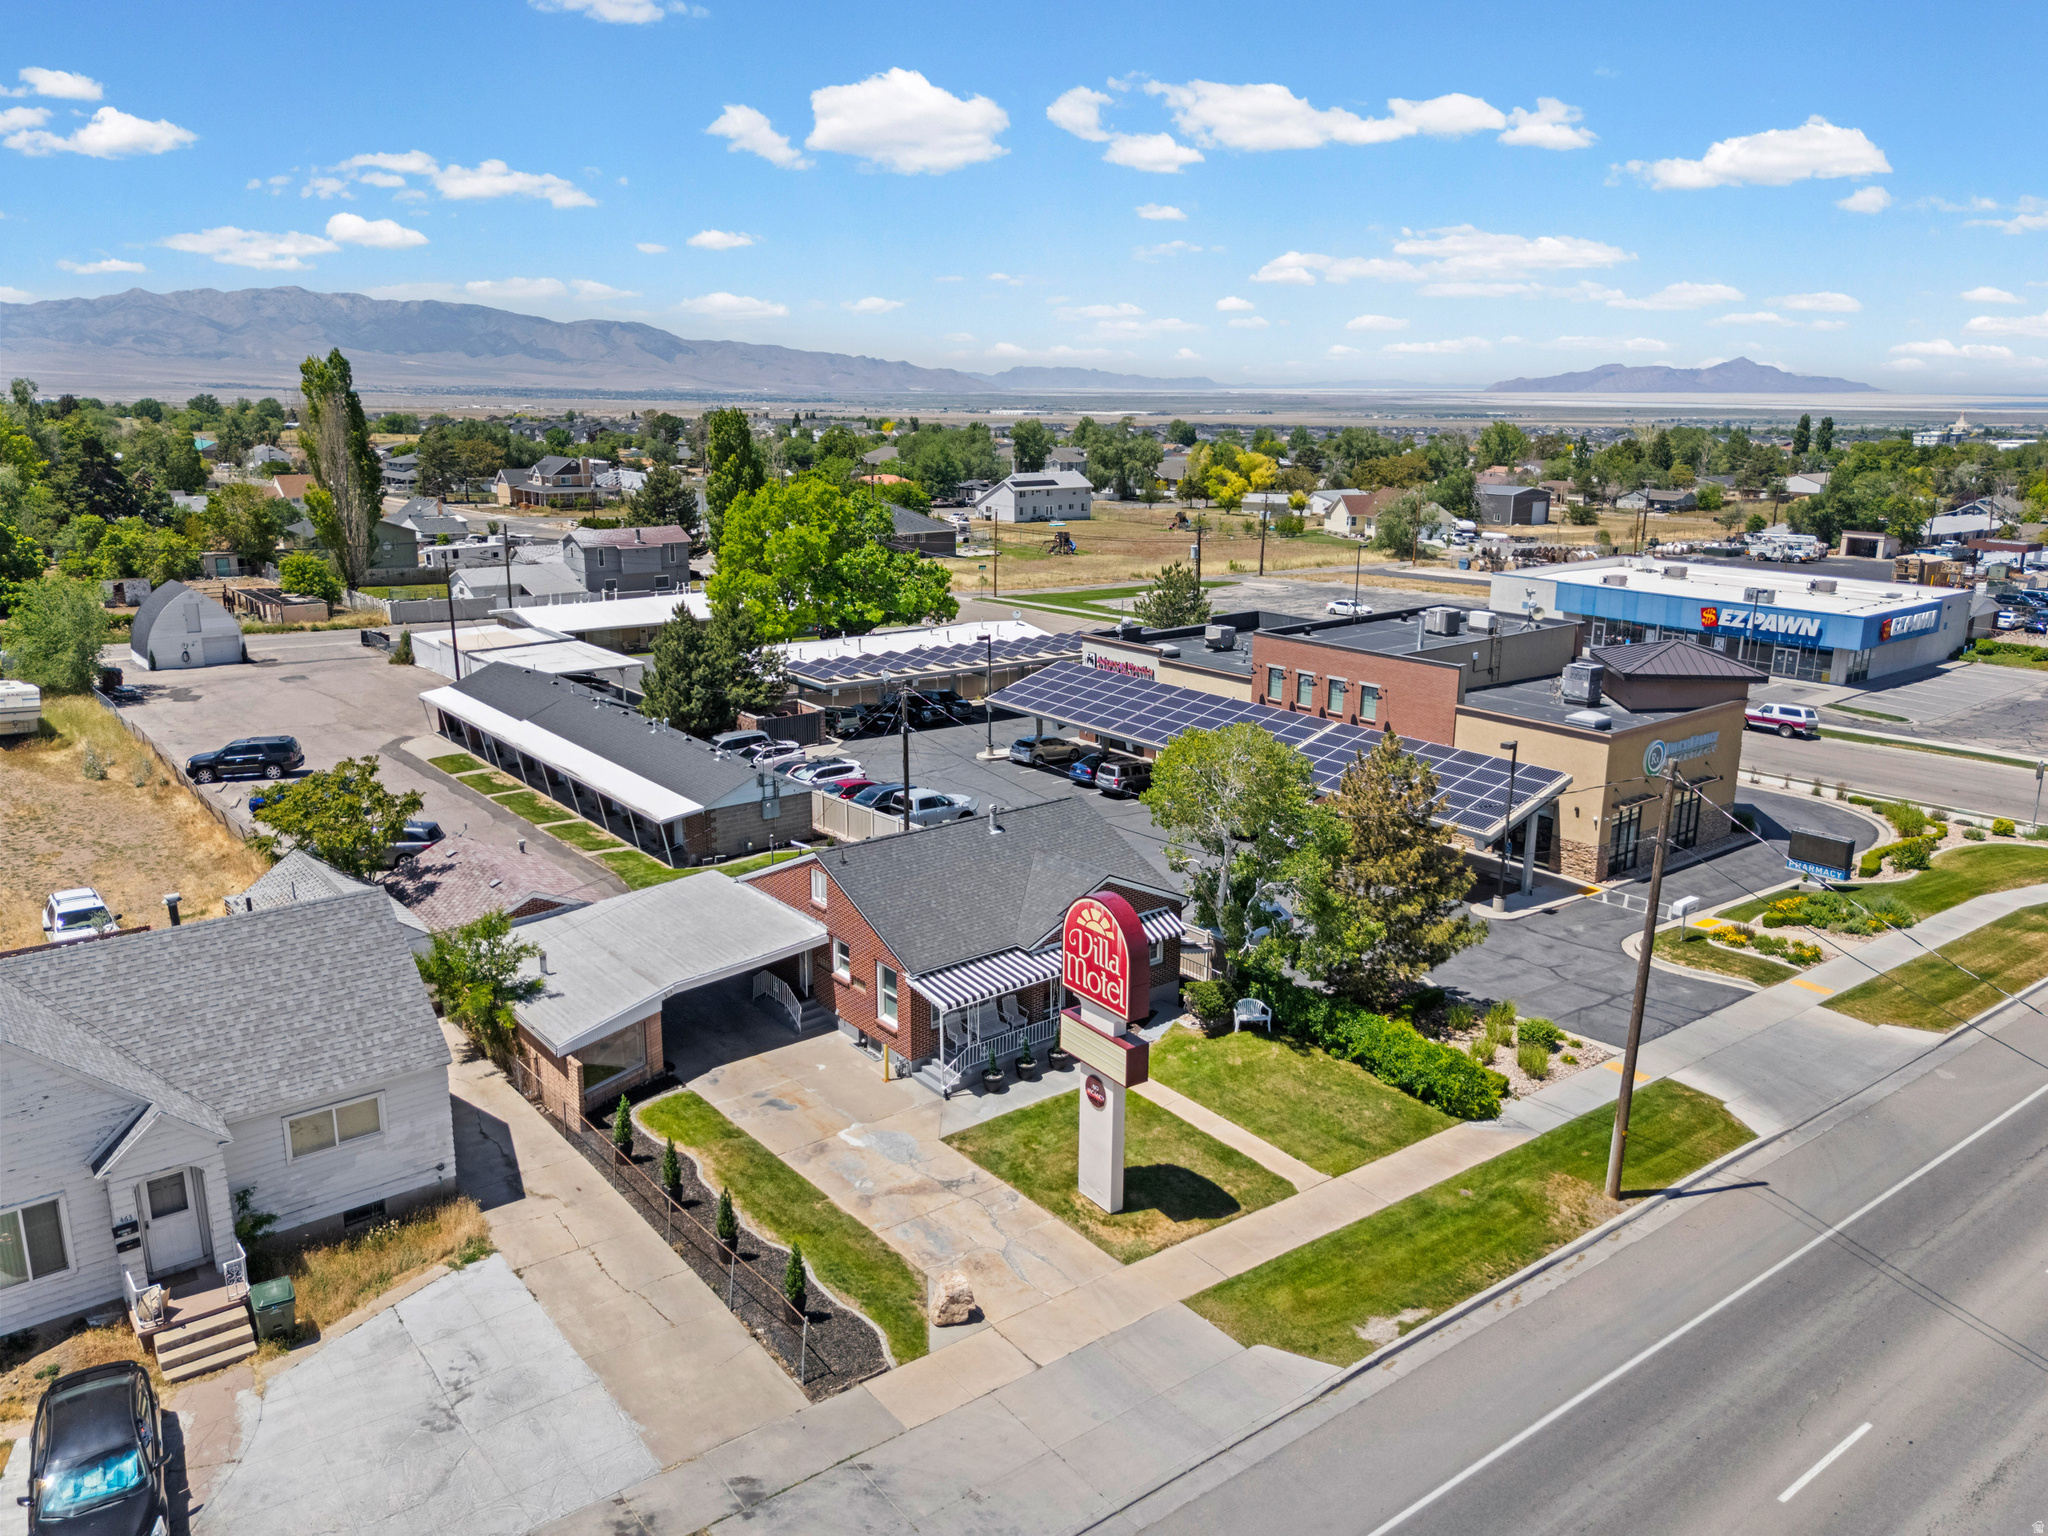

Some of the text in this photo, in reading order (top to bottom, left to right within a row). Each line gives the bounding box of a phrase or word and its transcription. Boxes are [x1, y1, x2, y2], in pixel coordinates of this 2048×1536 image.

[1718, 608, 1821, 637] EZPAWN
[1788, 861, 1842, 879] PHARMACY
[1069, 928, 1121, 977] Villa
[1065, 950, 1126, 1009] Motel
